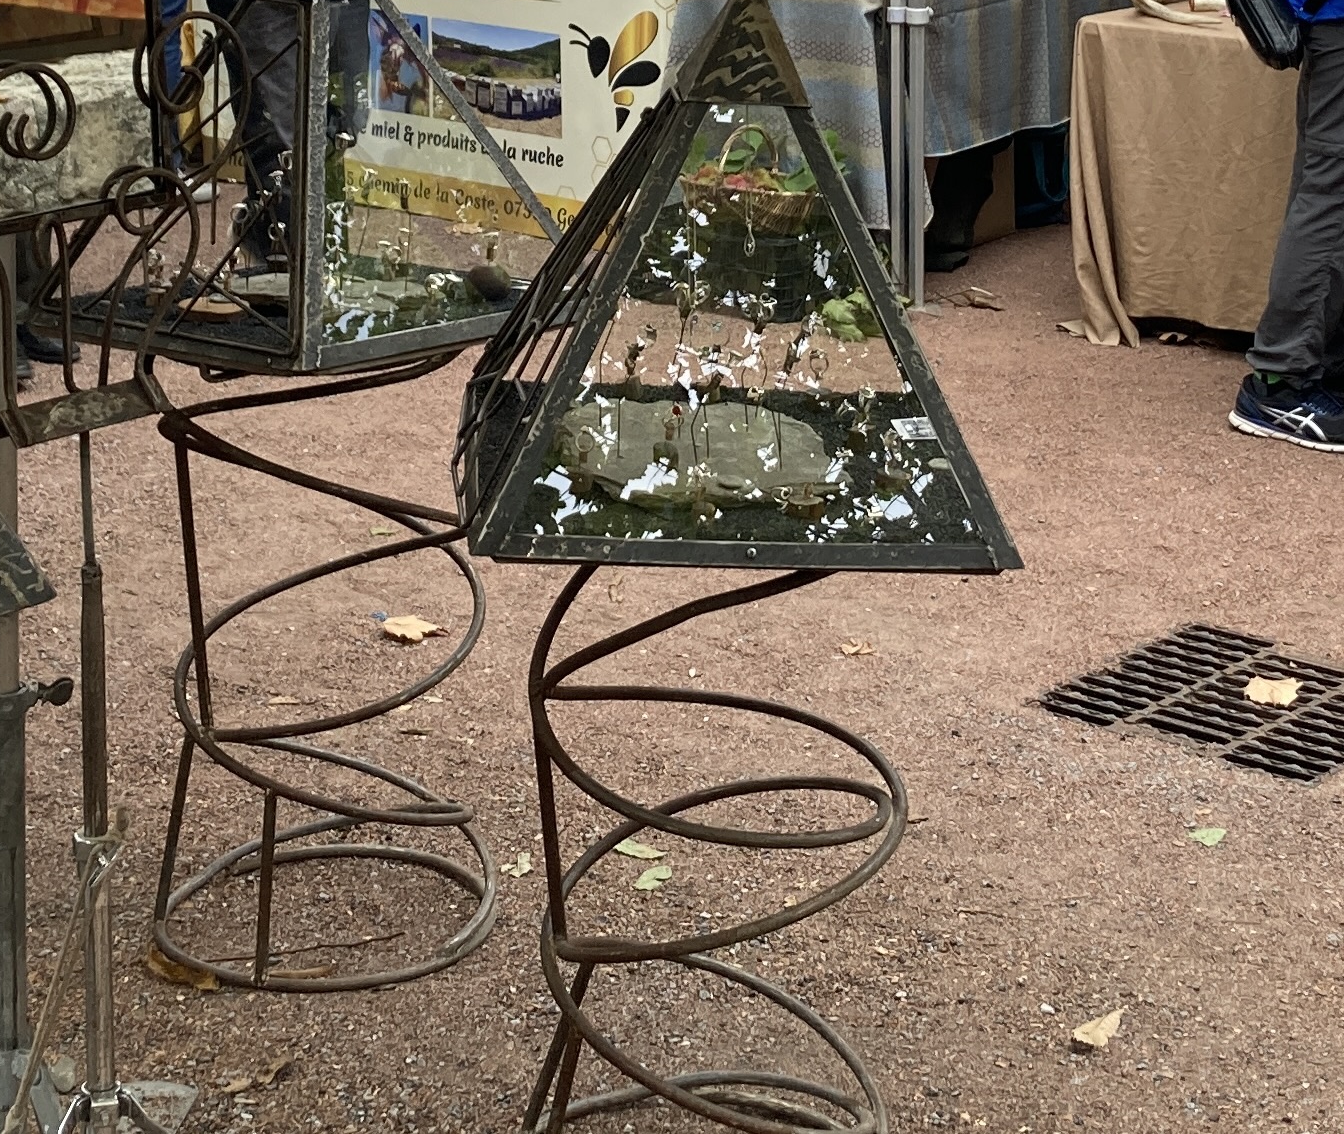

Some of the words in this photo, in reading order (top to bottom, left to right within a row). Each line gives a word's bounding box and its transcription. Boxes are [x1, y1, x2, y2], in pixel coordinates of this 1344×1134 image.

[371, 120, 400, 140] miel
[403, 124, 415, 147] &
[417, 128, 477, 154] produits
[522, 145, 564, 168] ruche
[358, 175, 410, 197] cemin
[414, 178, 431, 200] de
[436, 181, 449, 203] la
[503, 199, 552, 222] 075
